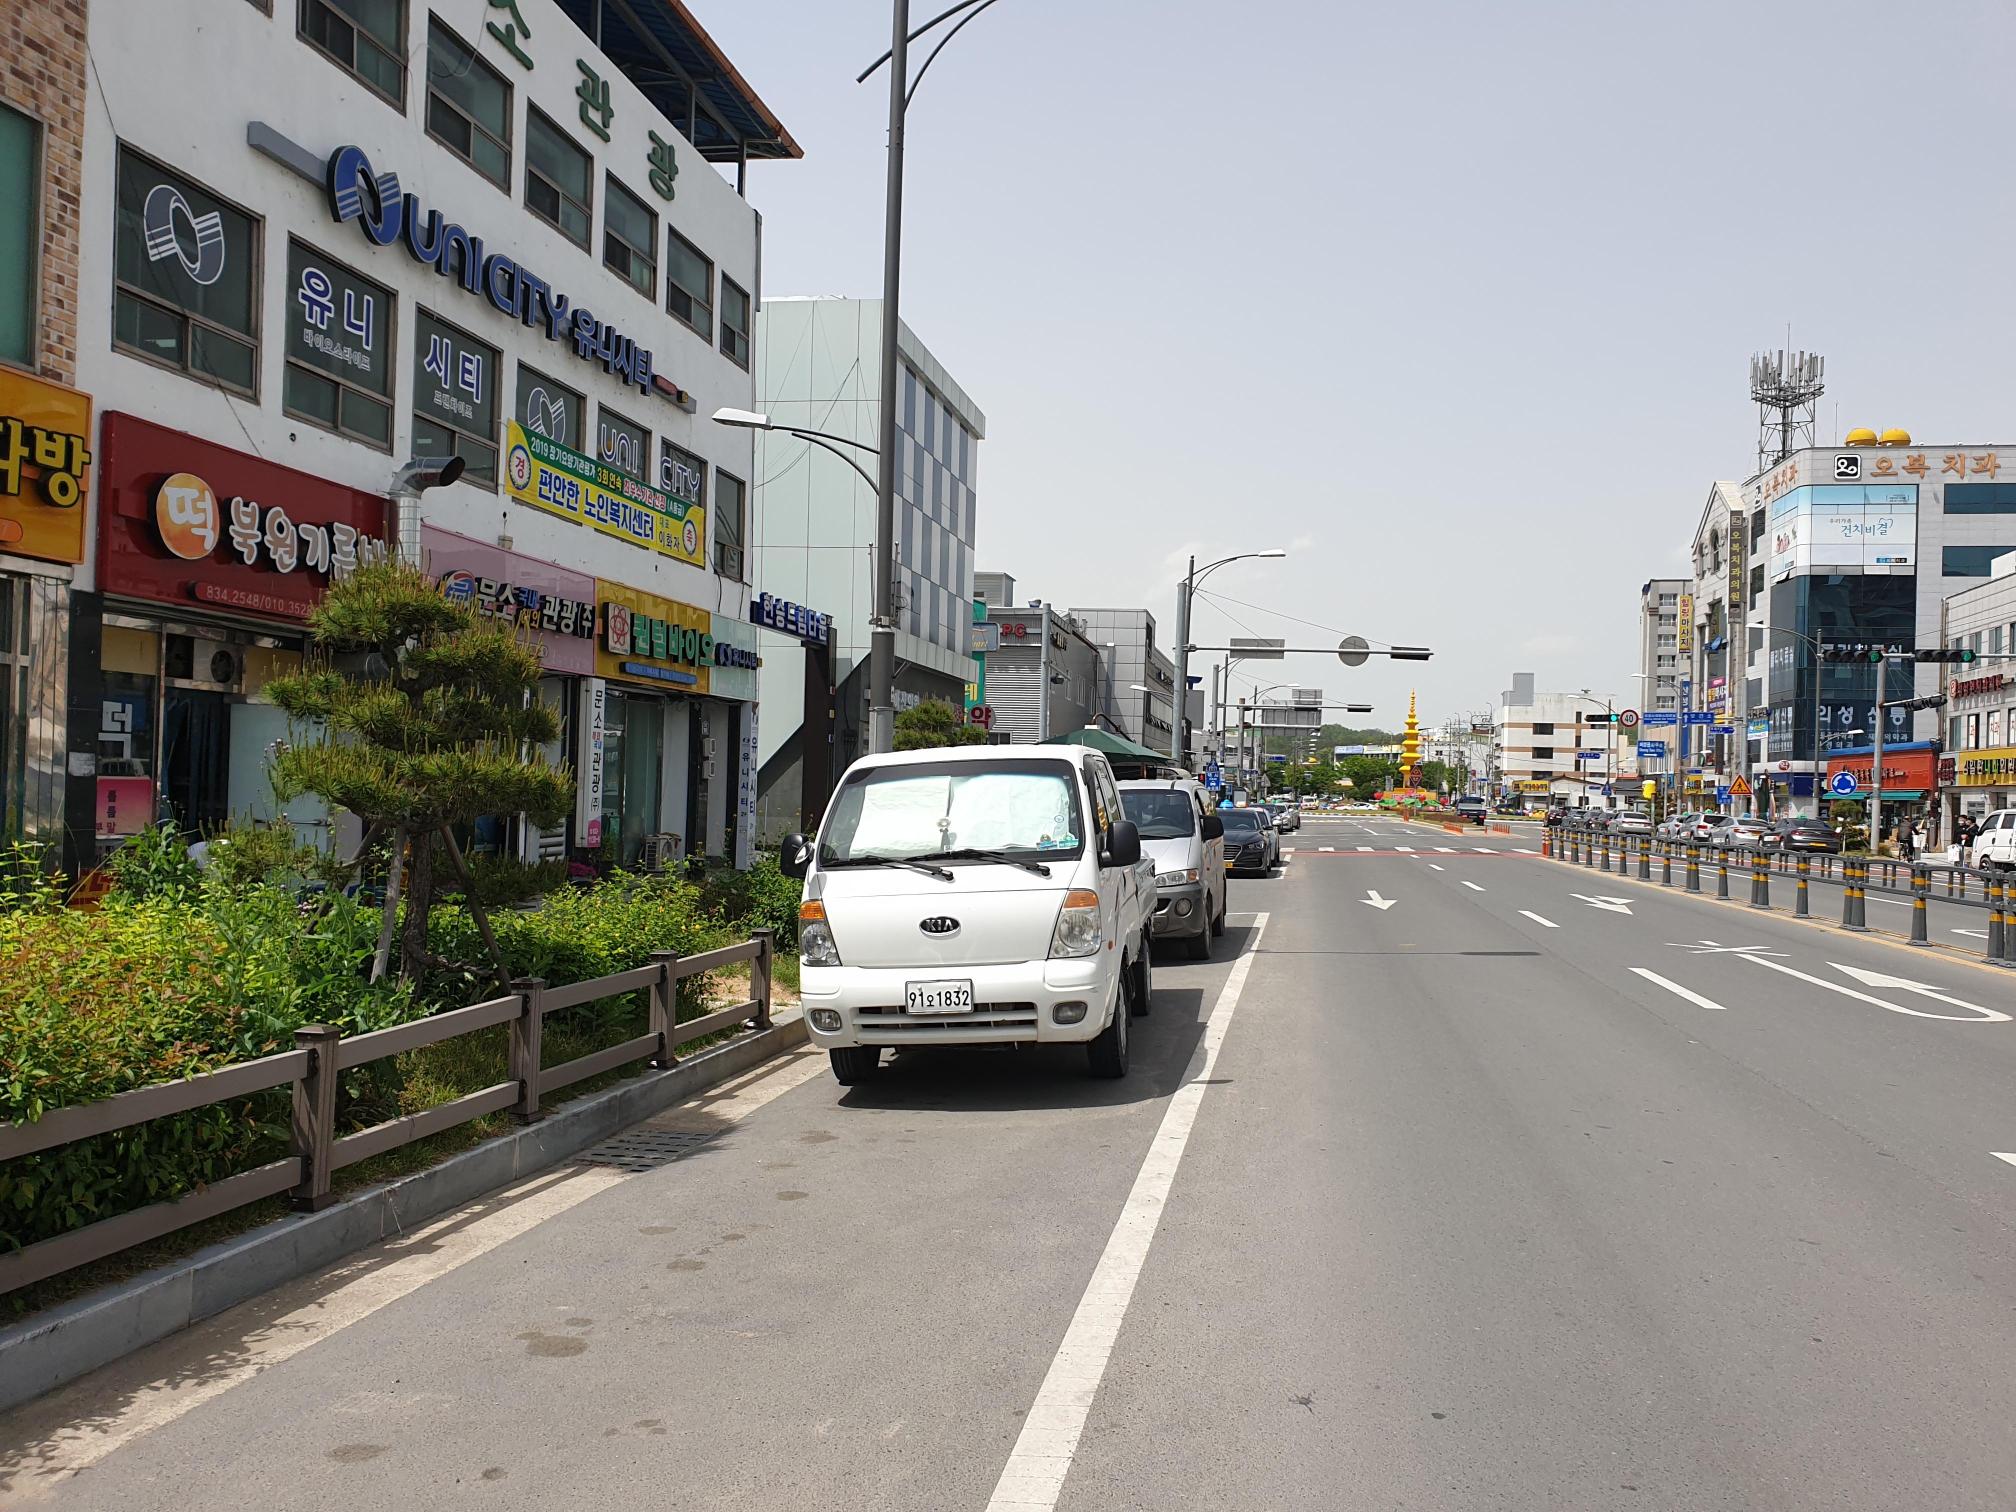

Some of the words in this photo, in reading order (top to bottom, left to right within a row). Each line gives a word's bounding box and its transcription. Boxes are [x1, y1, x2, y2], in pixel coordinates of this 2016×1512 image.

[403, 193, 569, 341] UNICITY
[572, 308, 653, 397] 유니시티
[531, 437, 549, 456] 2019
[515, 455, 526, 480] 경
[601, 423, 639, 473] UNI
[660, 456, 701, 501] CITY
[538, 467, 580, 512] 편안한
[584, 487, 655, 540] 노인복지센터
[163, 485, 216, 551] 떡
[632, 613, 716, 668] 퀀텀바이오
[1001, 622, 1027, 638] PC
[970, 706, 992, 730] 약
[1624, 714, 1635, 724] 40
[926, 918, 955, 932] KIA
[908, 989, 970, 1009] 91오1832
